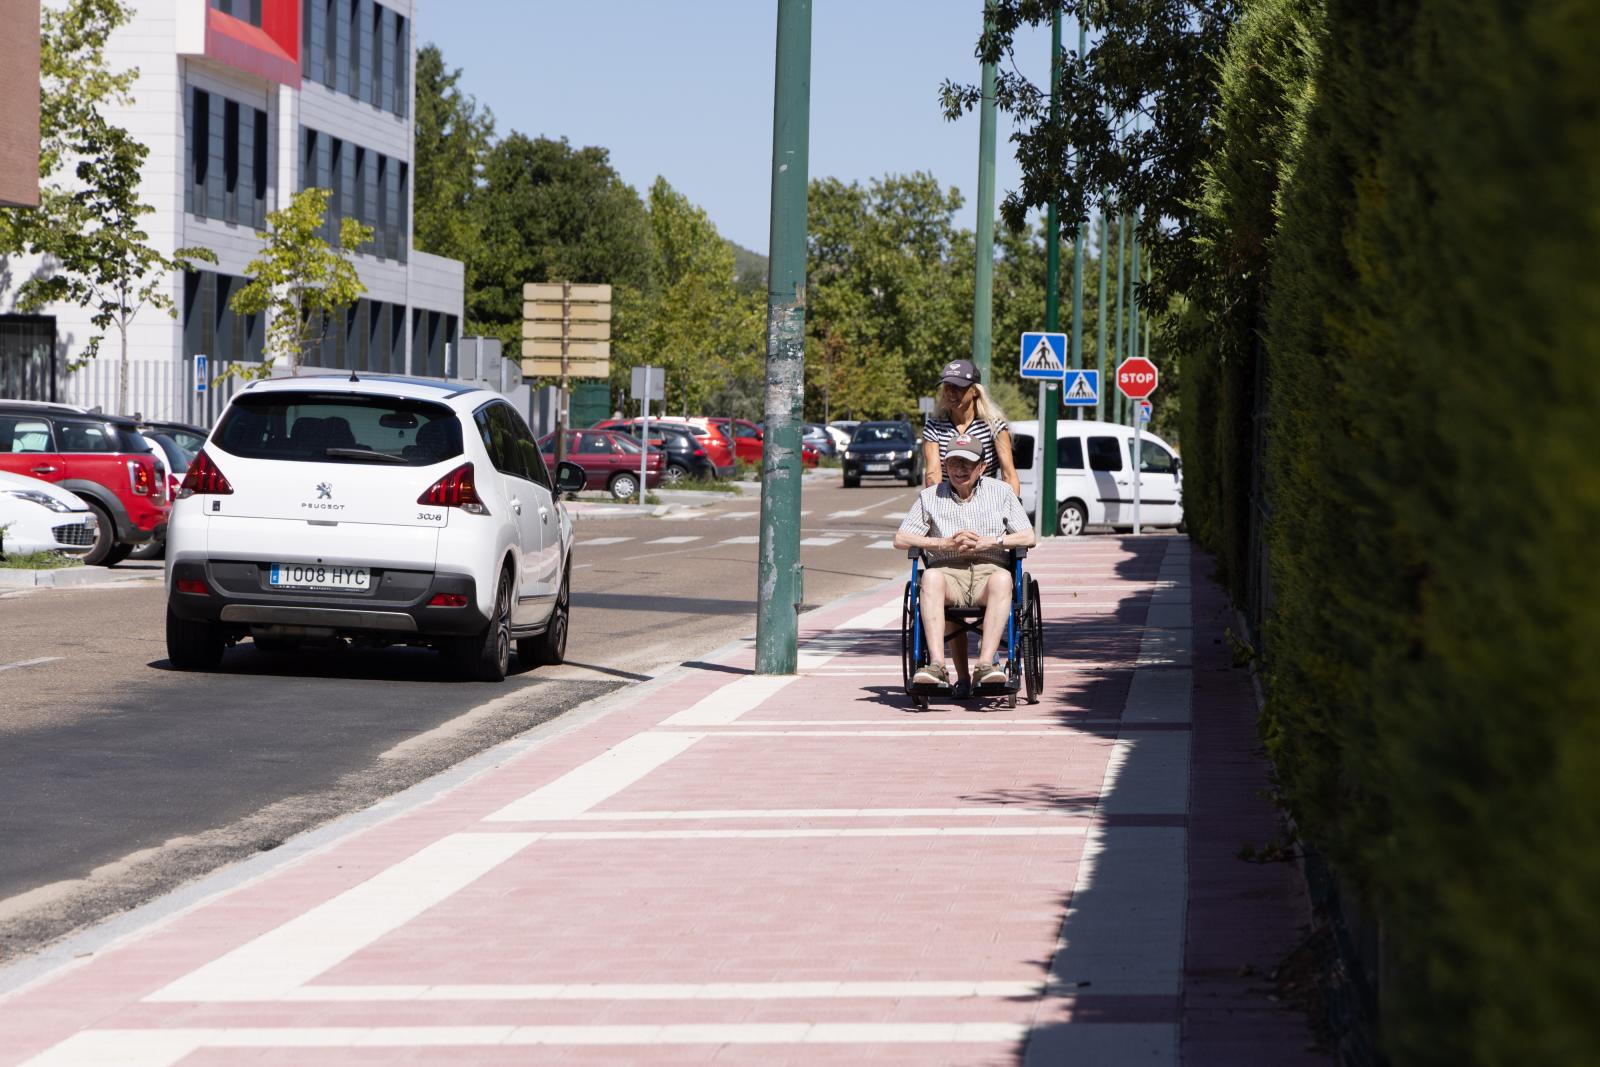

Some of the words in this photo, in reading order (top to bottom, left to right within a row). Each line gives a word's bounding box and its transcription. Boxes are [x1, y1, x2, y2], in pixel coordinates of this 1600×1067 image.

[1121, 372, 1154, 384] STOP
[301, 502, 345, 510] PEUGEOT
[416, 512, 442, 521] 3008
[285, 566, 326, 583] 1008
[332, 568, 366, 585] HYC
